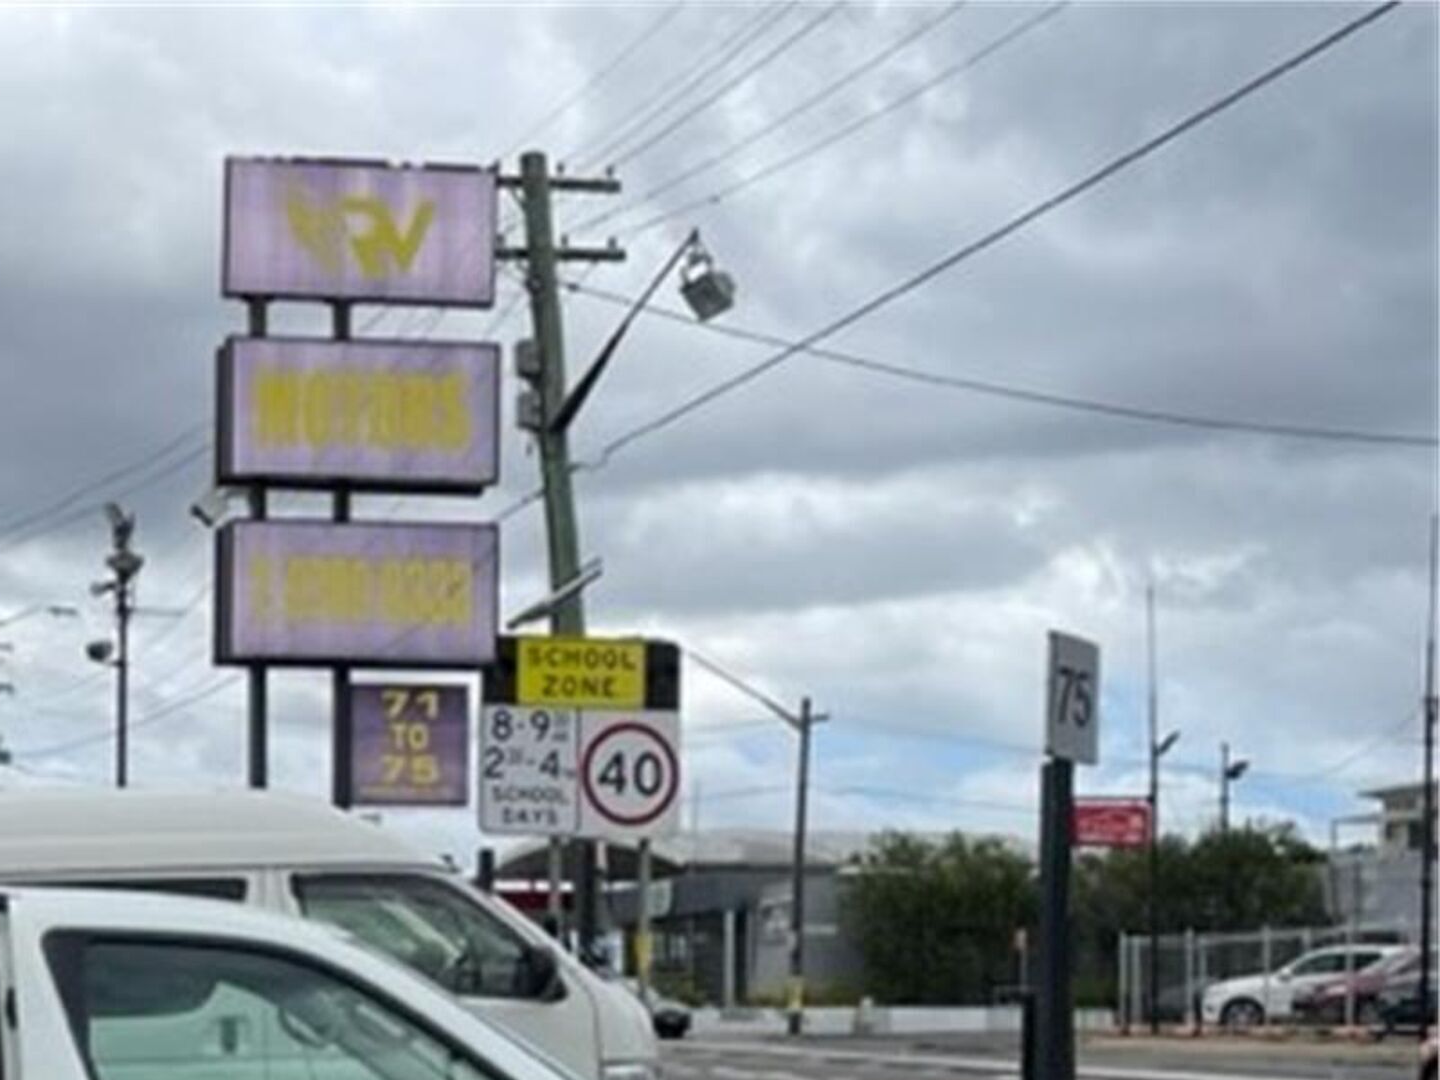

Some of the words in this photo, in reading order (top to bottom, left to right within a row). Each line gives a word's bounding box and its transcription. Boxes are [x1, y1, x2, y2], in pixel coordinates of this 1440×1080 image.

[527, 645, 636, 671] SCHOOL
[541, 674, 615, 698] ZONE
[1057, 665, 1092, 728] 75
[381, 689, 440, 720] 71
[391, 722, 430, 750] TO
[381, 754, 440, 784] 75
[597, 749, 664, 798] 40
